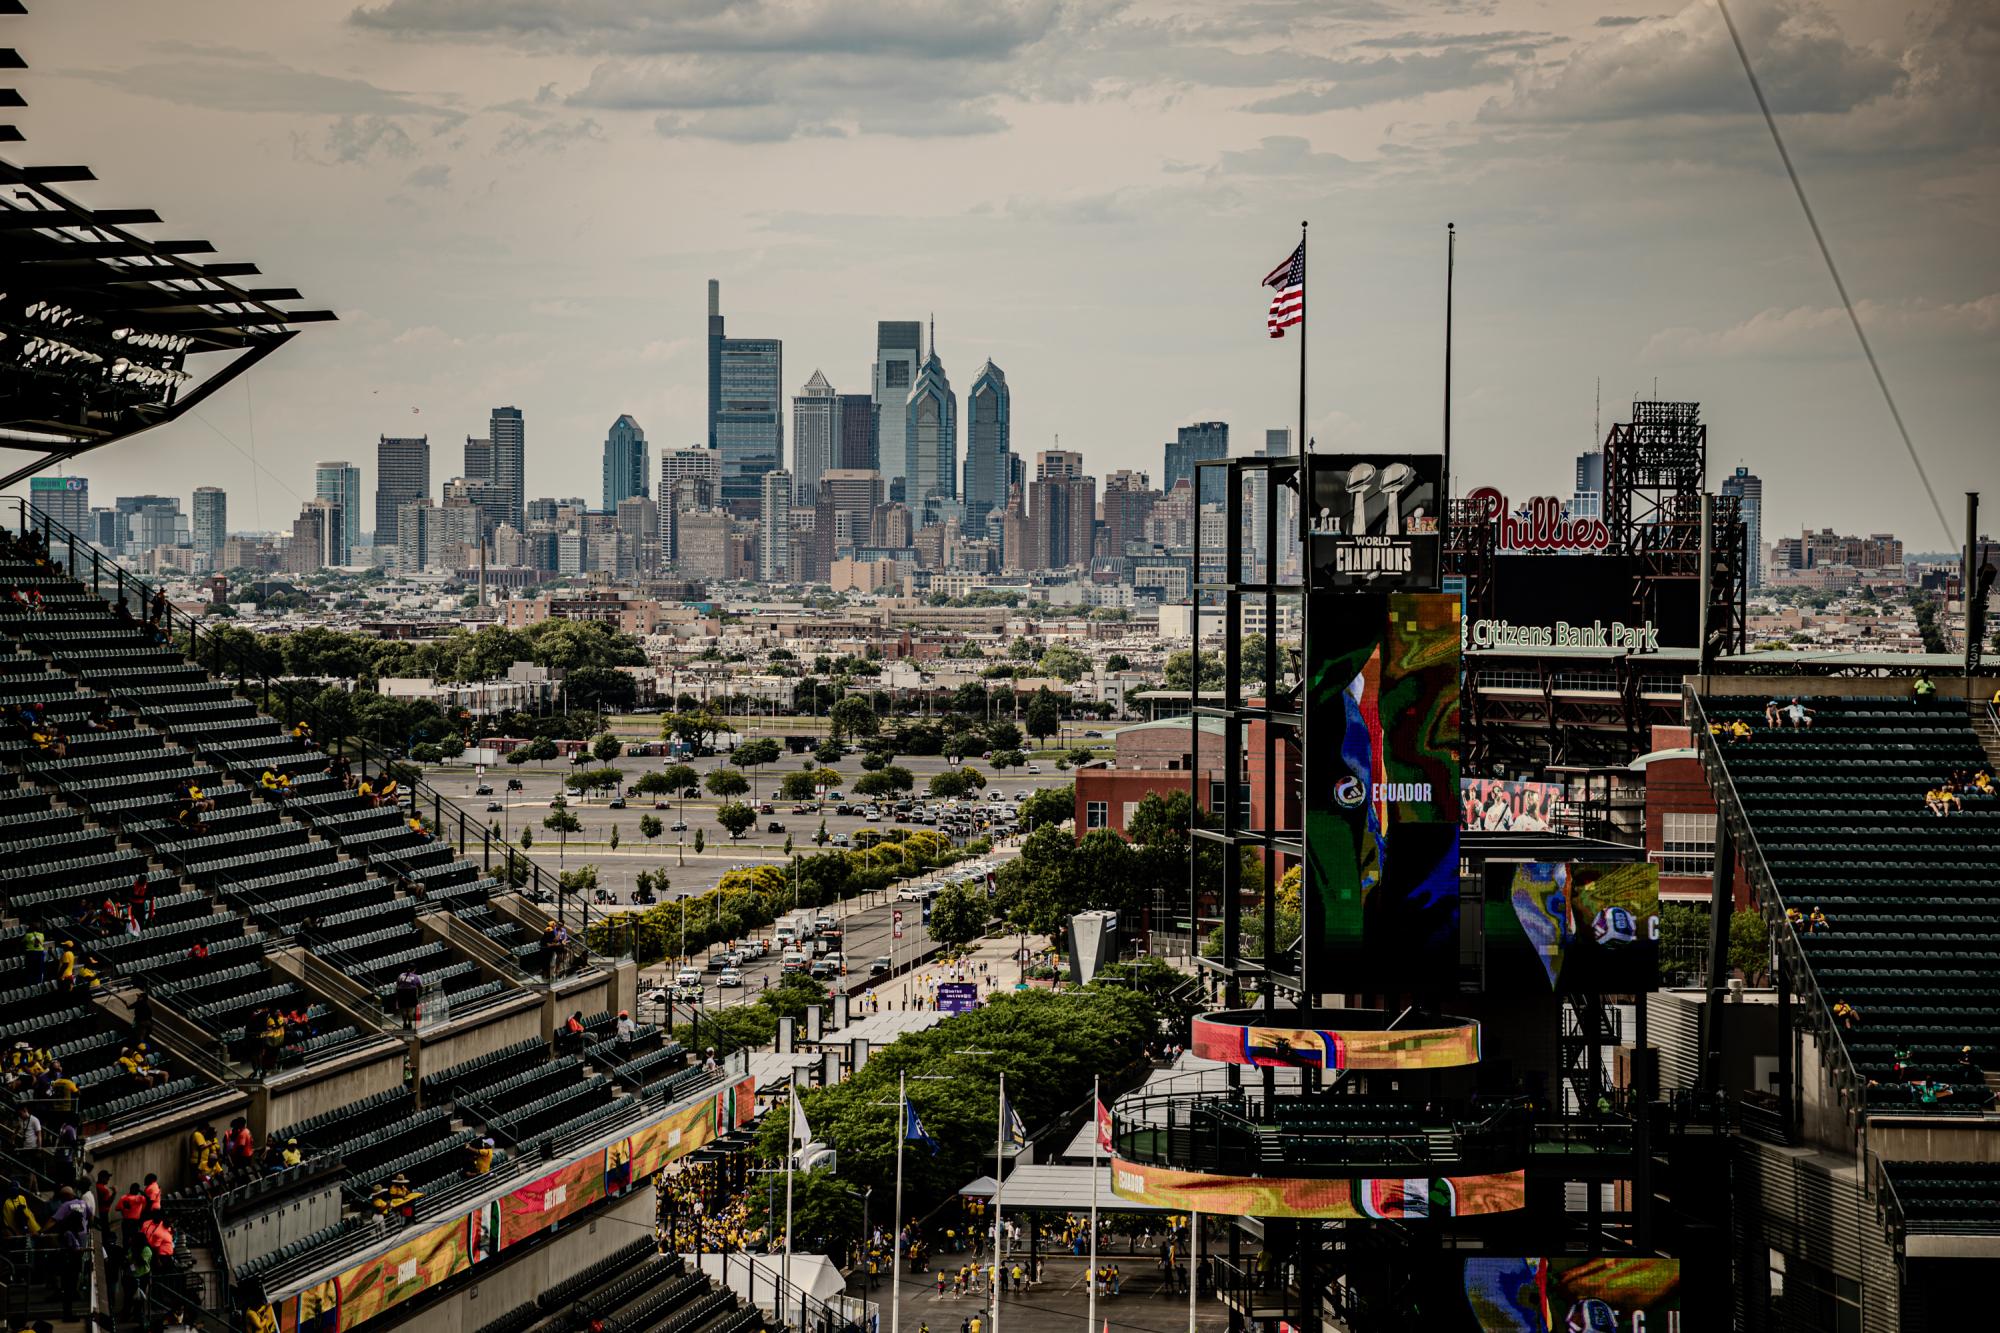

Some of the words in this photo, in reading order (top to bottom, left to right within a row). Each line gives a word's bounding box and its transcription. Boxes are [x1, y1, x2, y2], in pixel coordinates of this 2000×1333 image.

[1467, 486, 1610, 550] Phillies
[1355, 536, 1391, 547] WORLD
[1336, 547, 1412, 572] CHAMPIONS
[1473, 619, 1552, 647] Citizens
[1556, 620, 1607, 648] Bank
[1612, 621, 1659, 649] Park
[1372, 782, 1432, 802] ECUADOR
